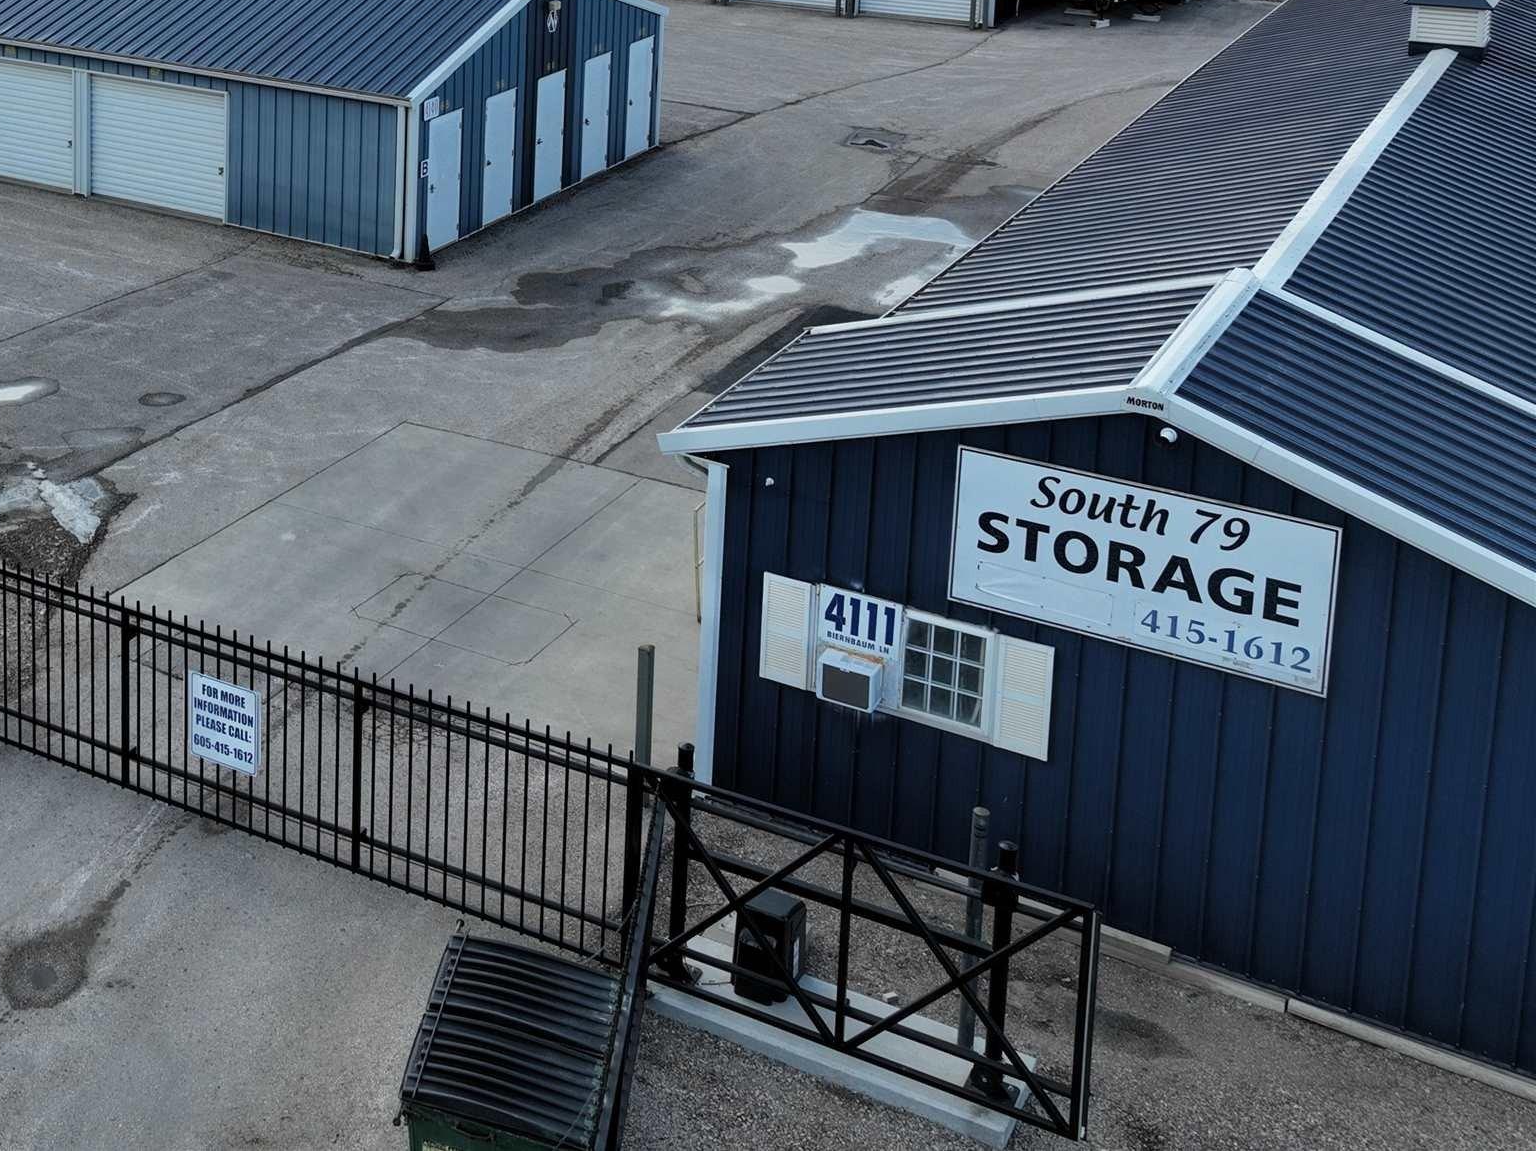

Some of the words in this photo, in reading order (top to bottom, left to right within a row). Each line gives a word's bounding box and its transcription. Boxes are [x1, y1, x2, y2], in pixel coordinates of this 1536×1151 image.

[422, 161, 429, 176] B
[1125, 396, 1165, 411] MORTON
[1030, 476, 1169, 535] South
[1188, 508, 1251, 552] 79
[976, 511, 1303, 628] STORAGE
[824, 592, 896, 646] 4111
[826, 630, 876, 652] BIERNBAUM
[879, 645, 890, 655] LN
[1140, 607, 1313, 675] 415-1612
[202, 684, 219, 700] FOR
[220, 689, 246, 709] MORE
[193, 697, 254, 728] INFORMATION
[195, 713, 227, 735] PLEASE
[228, 724, 252, 743] CALL:
[193, 733, 253, 764] 605-415-1612
